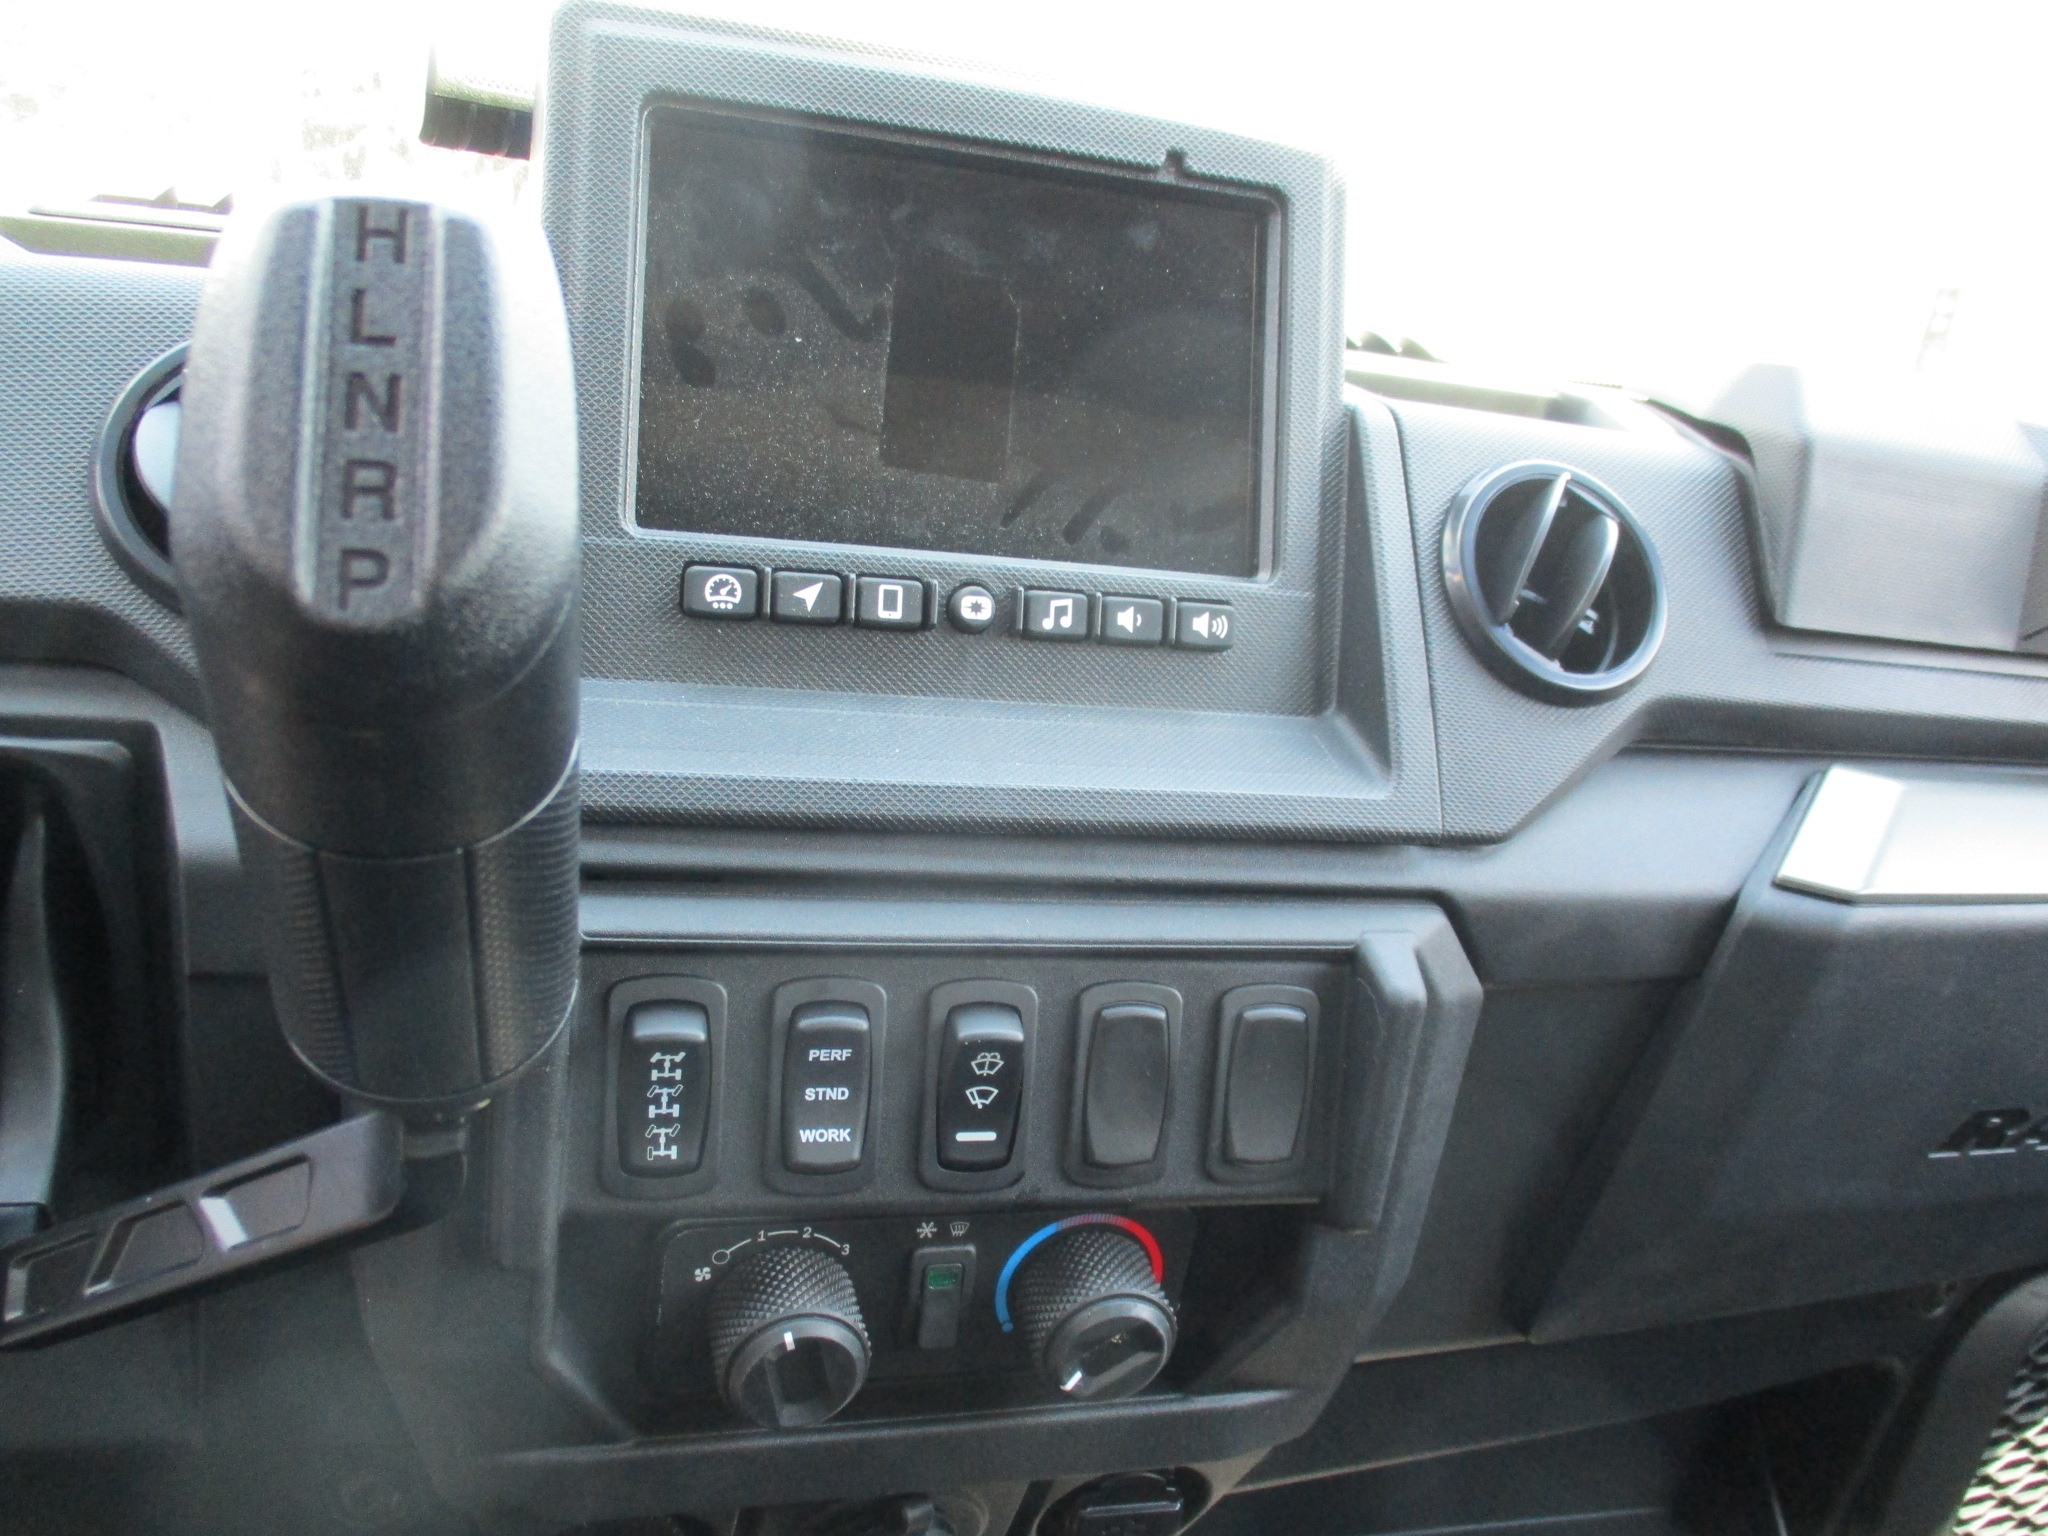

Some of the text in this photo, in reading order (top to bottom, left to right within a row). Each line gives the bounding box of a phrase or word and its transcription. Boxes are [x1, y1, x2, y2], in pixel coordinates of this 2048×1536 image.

[356, 205, 409, 264] H
[350, 288, 397, 345] L
[344, 371, 401, 433] N
[340, 457, 399, 521] R
[337, 547, 392, 610] P
[808, 1048, 853, 1062] PERF
[804, 1087, 850, 1102] STND
[798, 1127, 852, 1144] WORK
[757, 1229, 767, 1242] 1
[803, 1226, 813, 1240] 2
[841, 1243, 851, 1257] 3
